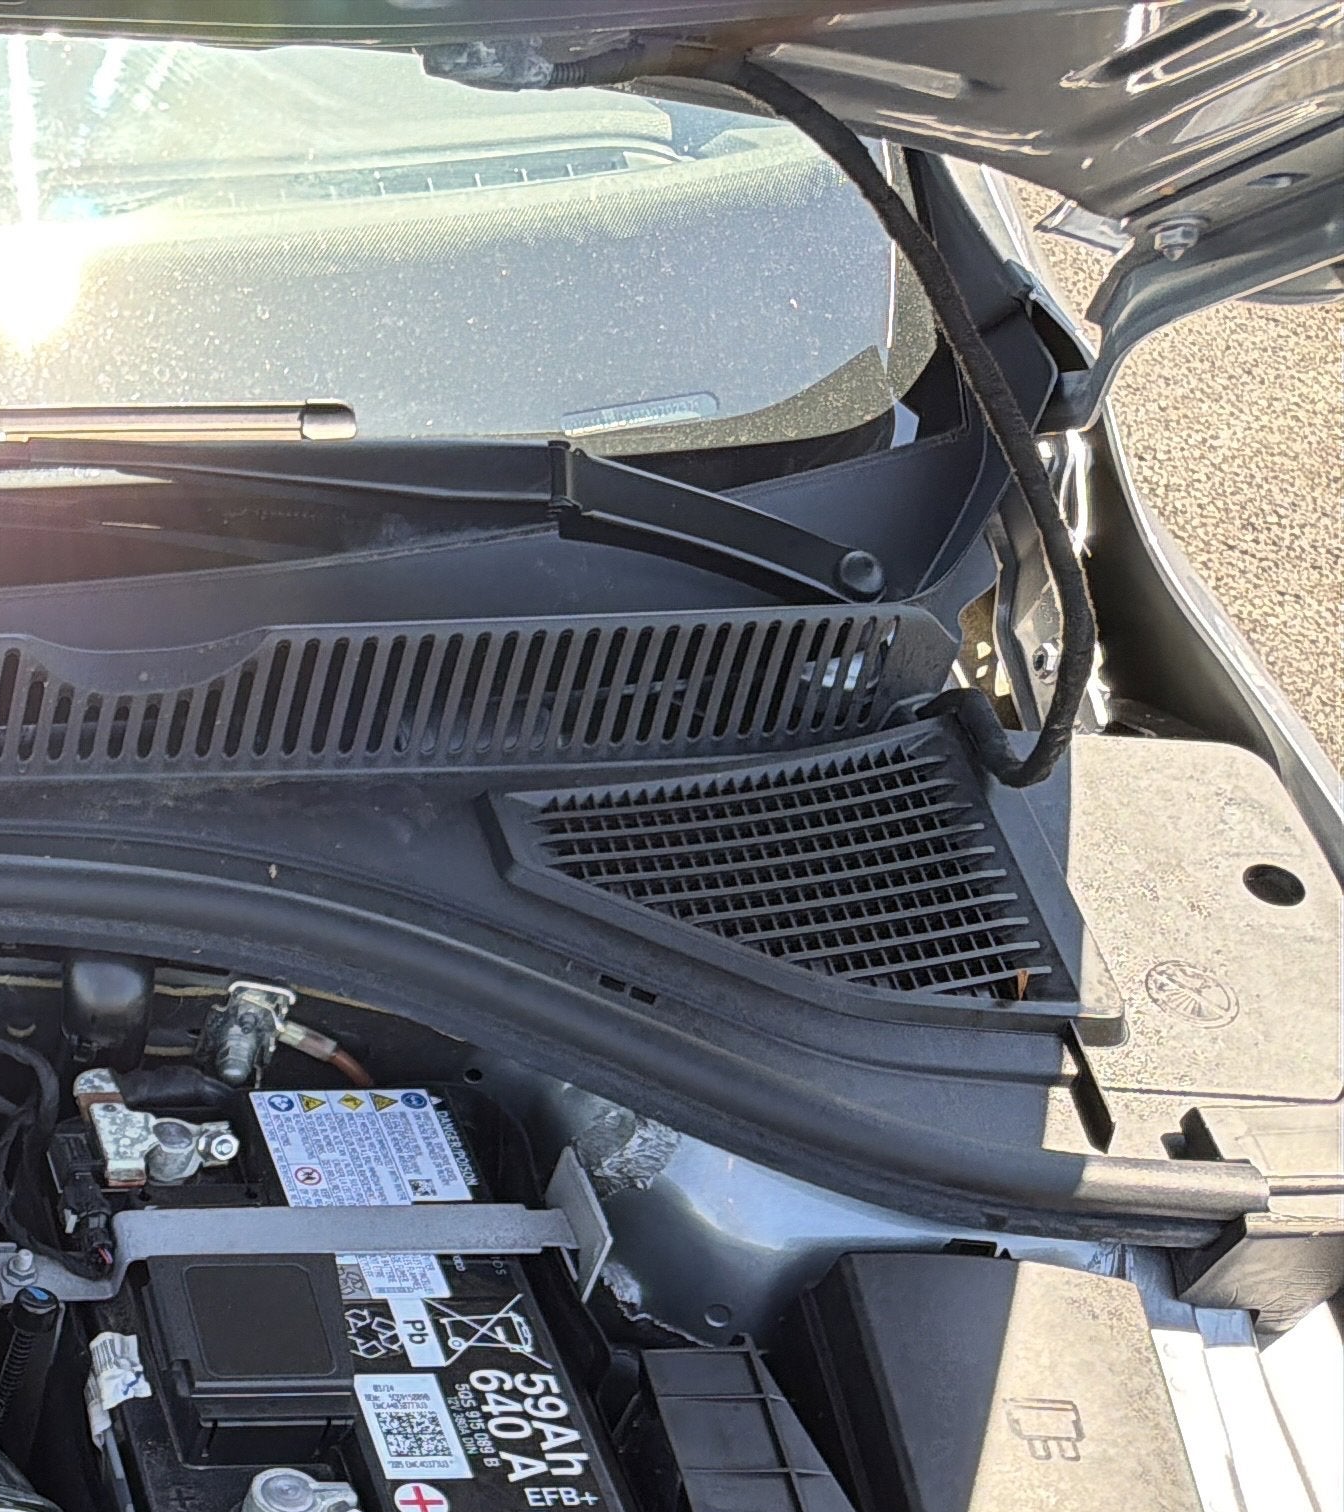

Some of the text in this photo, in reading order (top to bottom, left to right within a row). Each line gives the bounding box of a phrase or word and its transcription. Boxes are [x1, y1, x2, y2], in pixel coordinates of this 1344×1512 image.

[403, 1319, 429, 1346] Pb
[469, 1369, 533, 1440] 640
[514, 1372, 590, 1477] 59Ah
[462, 1436, 479, 1456] DIN
[498, 1451, 549, 1483] A
[523, 1486, 600, 1507] EFB+
